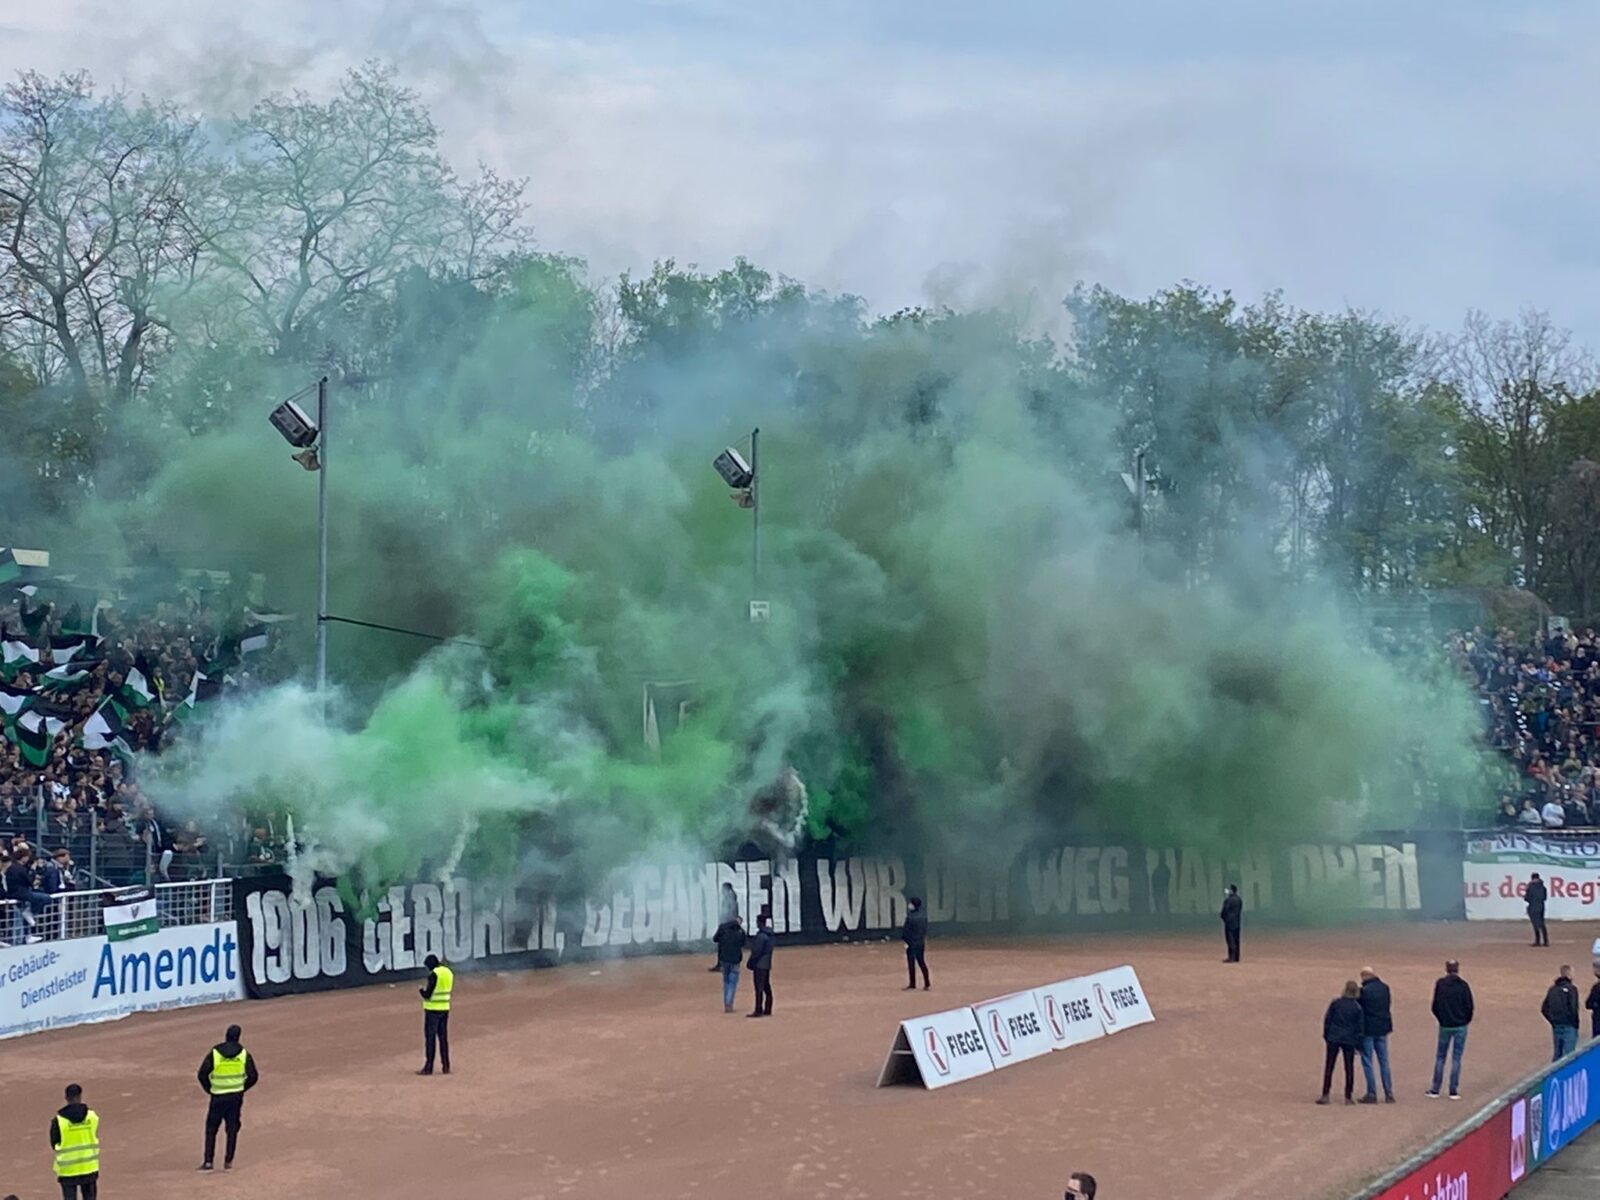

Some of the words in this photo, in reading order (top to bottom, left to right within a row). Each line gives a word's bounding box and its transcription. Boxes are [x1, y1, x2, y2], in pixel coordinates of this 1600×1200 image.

[1499, 875, 1528, 898] de
[247, 886, 347, 985] 1906
[817, 856, 907, 932] WIR
[1026, 846, 1130, 914] WEG
[9, 949, 61, 982] Gebäude-
[92, 928, 236, 998] Amendt
[21, 968, 87, 1008] Dienstleister
[1111, 985, 1139, 1011] FIEGE
[1008, 1012, 1041, 1040] FIEGE
[1062, 998, 1093, 1024] FIEGE
[946, 1029, 984, 1058] FIEGE
[1562, 1068, 1588, 1131] JAKO
